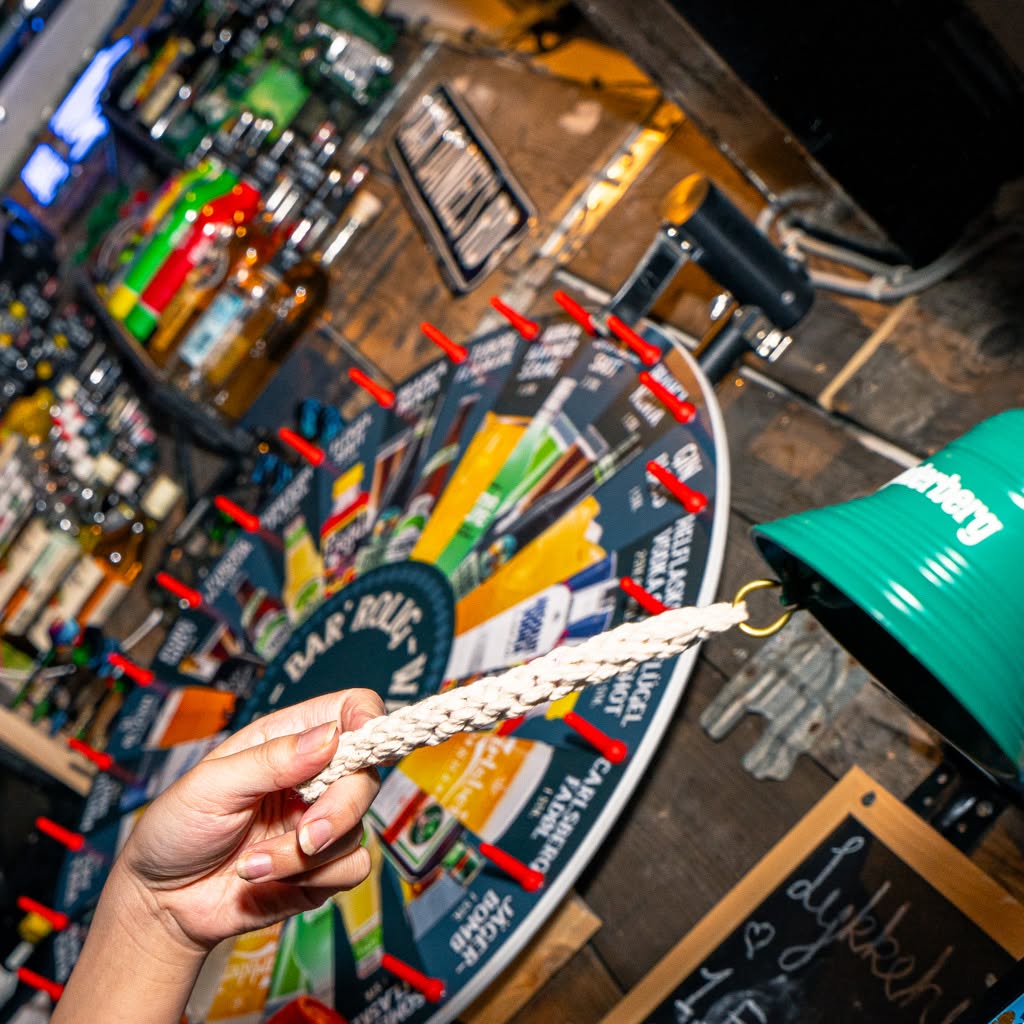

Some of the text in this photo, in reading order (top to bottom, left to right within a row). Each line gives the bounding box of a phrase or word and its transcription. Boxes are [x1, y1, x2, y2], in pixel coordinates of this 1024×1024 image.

[530, 758, 612, 873] CARLSBERG
[448, 889, 502, 954] BOMB
[456, 894, 515, 975] JÄGER-
